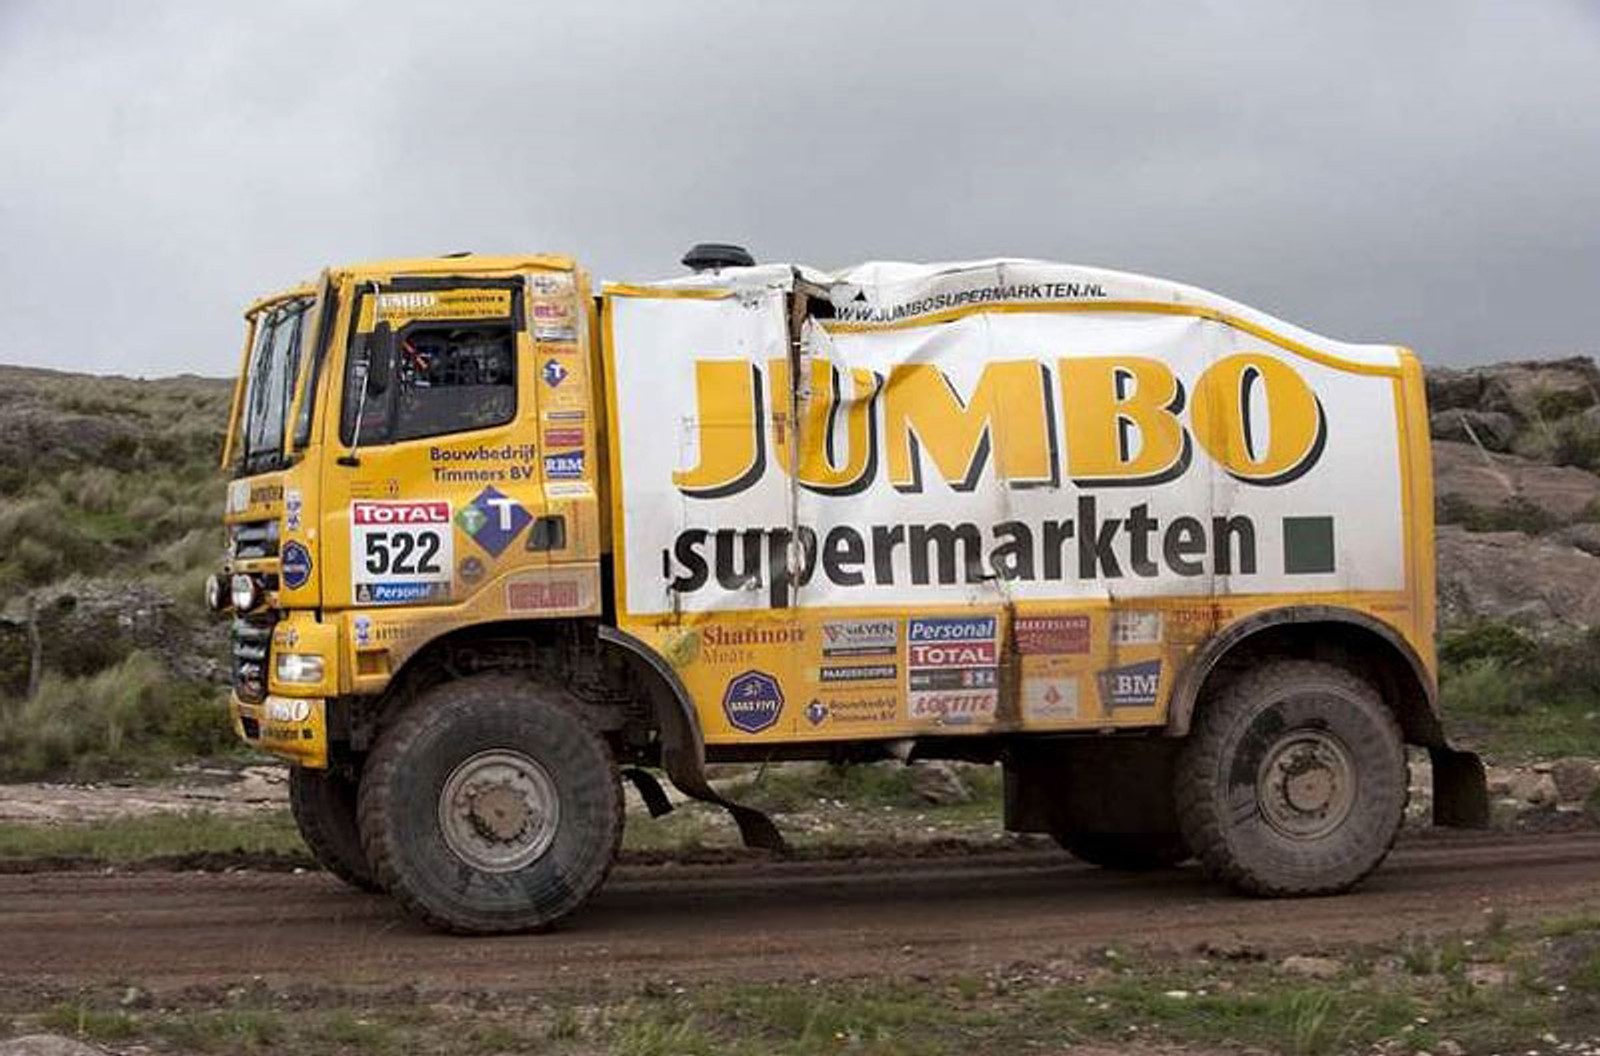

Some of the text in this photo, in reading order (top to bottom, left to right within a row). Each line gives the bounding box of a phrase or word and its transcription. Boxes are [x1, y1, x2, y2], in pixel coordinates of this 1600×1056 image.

[833, 283, 1107, 322] WW.JUMBOSUPERMARKTEN.NL
[672, 353, 1328, 498] JUMBO
[430, 444, 535, 463] Bouwbedrijf
[433, 466, 533, 481] Timmers BV
[356, 505, 446, 522] TOTAL
[366, 531, 441, 575] 522
[664, 496, 1256, 608] supermarkten
[375, 586, 431, 601] Personal
[703, 624, 804, 646] Shannon
[912, 620, 993, 639] Personal
[912, 645, 992, 664] TOTAL
[914, 695, 993, 714] LOCTITE
